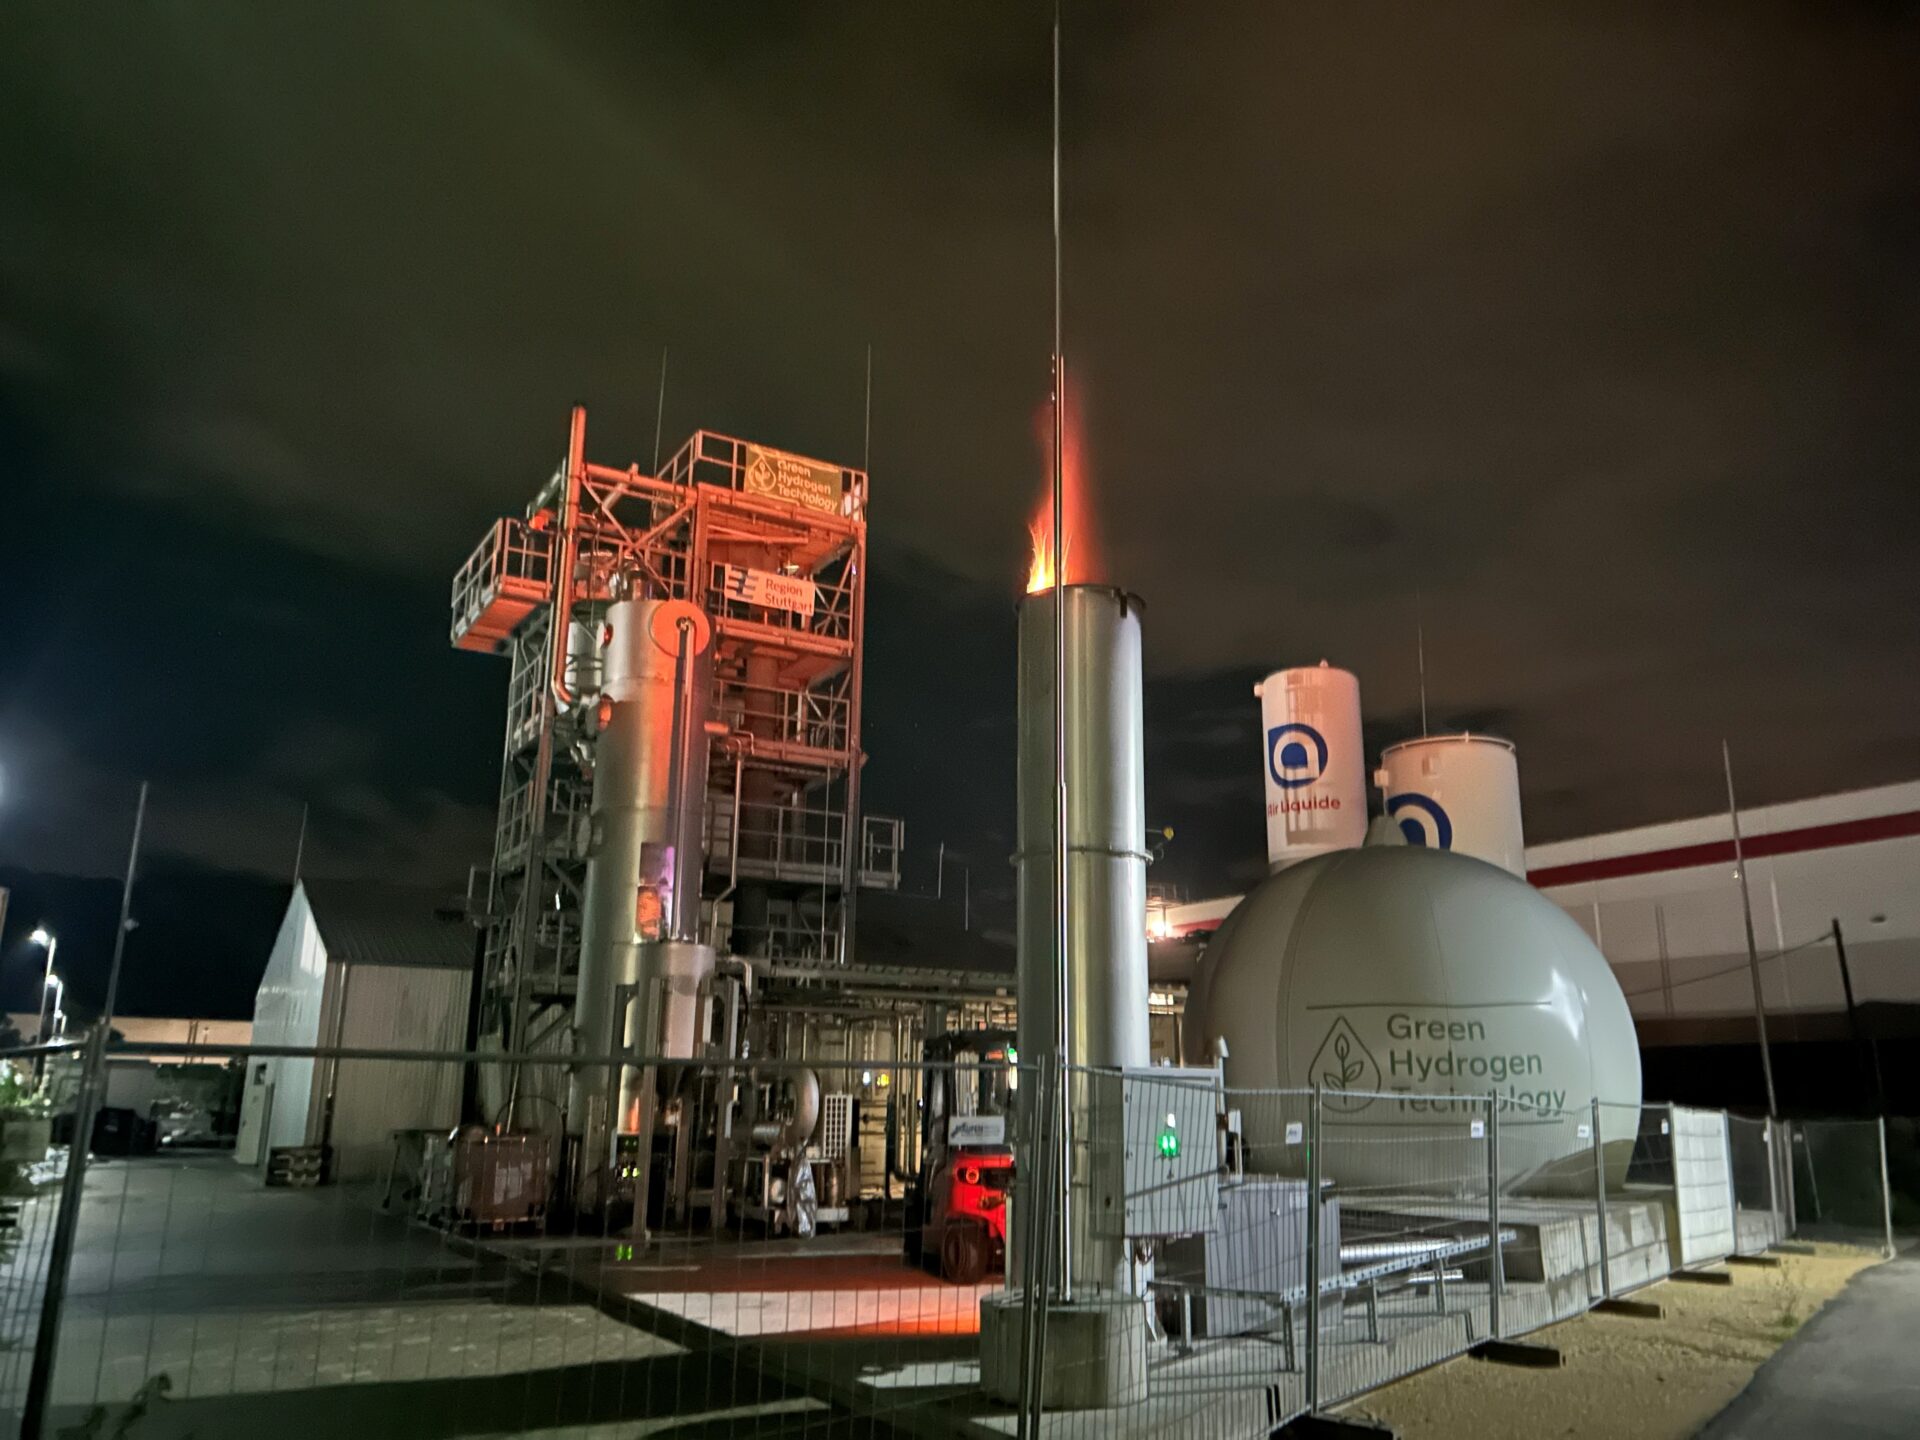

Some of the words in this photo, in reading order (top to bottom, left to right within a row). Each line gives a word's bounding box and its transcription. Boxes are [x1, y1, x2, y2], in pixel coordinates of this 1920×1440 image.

[777, 460, 810, 478] Green
[778, 470, 831, 495] Hydrogen
[777, 483, 838, 512] Technology
[766, 579, 802, 597] Region
[765, 593, 813, 613] Stuttgart
[1267, 802, 1279, 817] Air
[1281, 795, 1341, 815] Liquide
[1387, 1013, 1485, 1041] Green
[1390, 1049, 1542, 1082] Hydrogen
